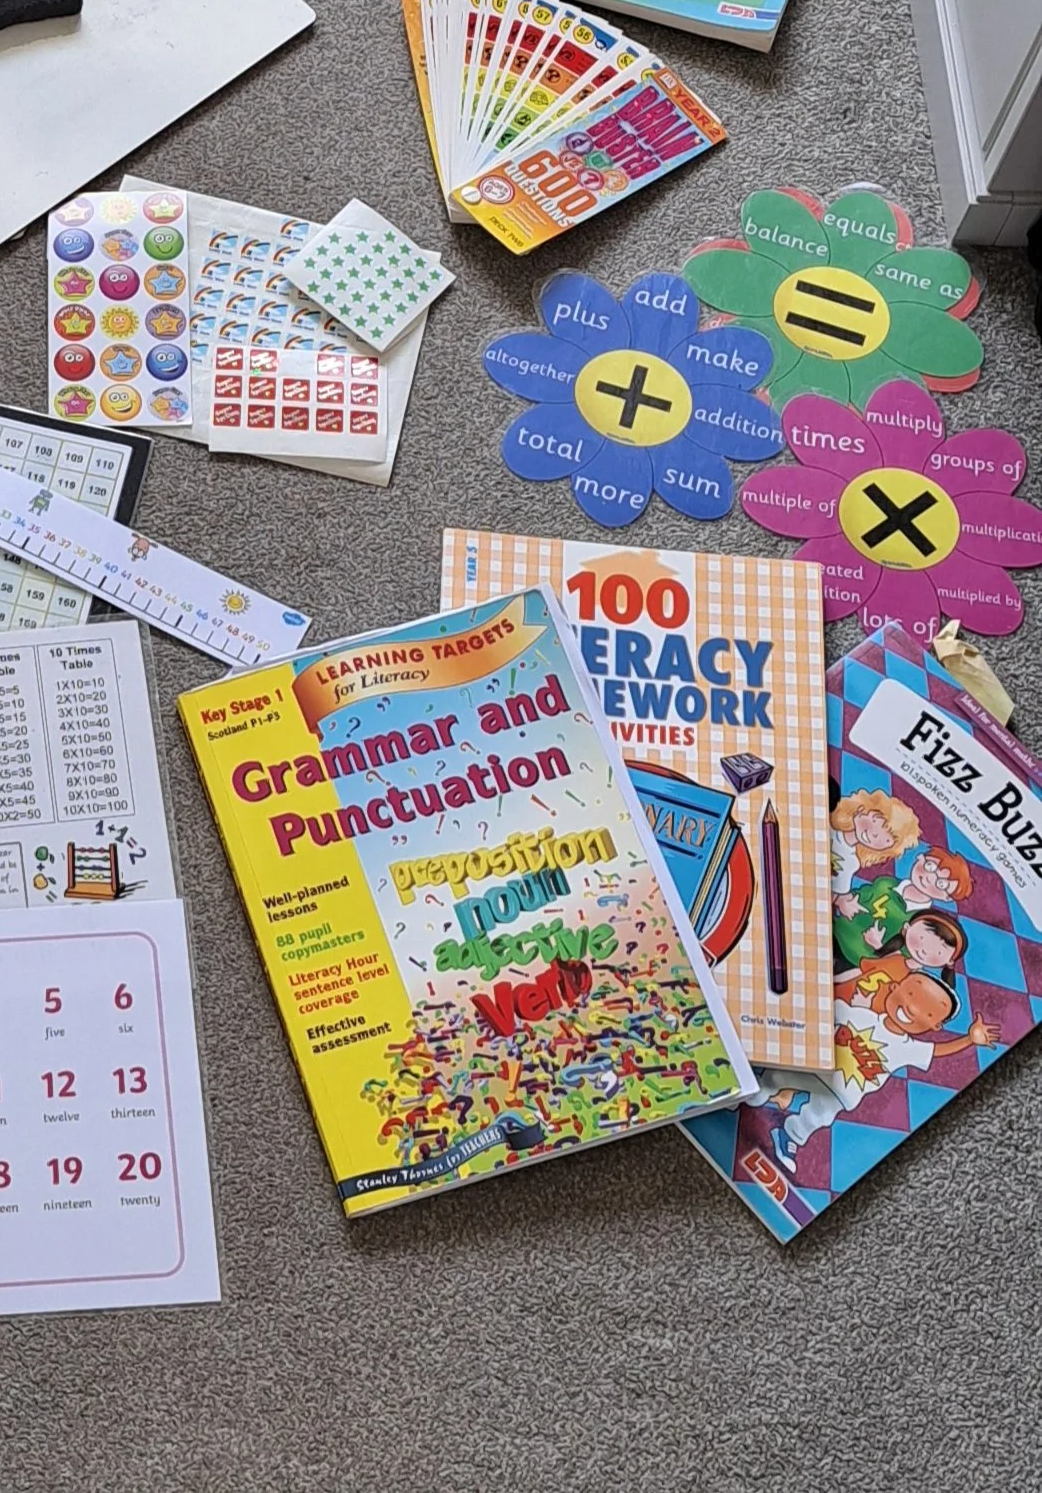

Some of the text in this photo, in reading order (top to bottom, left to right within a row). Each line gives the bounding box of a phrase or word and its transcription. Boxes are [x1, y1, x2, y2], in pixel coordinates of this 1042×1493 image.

[673, 88, 721, 138] YEAR 2
[505, 162, 575, 228] QUESTIONS
[518, 150, 598, 218] 600
[744, 215, 828, 258] balance
[823, 209, 897, 245] equals
[874, 260, 963, 301] same as
[553, 302, 609, 333] plus
[634, 287, 687, 318] add
[484, 347, 576, 384] altogether
[685, 342, 760, 377] make
[692, 406, 785, 445] addition
[791, 425, 867, 454] times
[866, 411, 944, 438] multiply
[517, 426, 584, 464] total
[661, 465, 723, 500] sum
[930, 453, 1024, 481] groups of
[573, 474, 646, 510] more
[741, 487, 837, 519] multiple of
[466, 545, 477, 584] YEAR 5
[566, 570, 691, 630] 100
[937, 587, 1022, 611] multiplied by
[315, 617, 516, 686] LEARNING TARGETS
[333, 666, 430, 705] for Literacy
[200, 689, 285, 726] Key Stage 1
[230, 673, 572, 804] Grammar and
[899, 710, 983, 794] Fizz
[269, 746, 572, 858] Punctuation
[387, 826, 619, 906] preposition
[262, 875, 350, 910] Well-planned
[453, 866, 572, 942] noun
[266, 899, 319, 925] lessons
[276, 922, 333, 949] 88 pupil
[280, 928, 366, 963] copymasters
[432, 916, 620, 982] adjective
[288, 952, 380, 987] Literacy Hour
[306, 1014, 367, 1041] Effective
[311, 1020, 392, 1055] assessment
[110, 1106, 157, 1120] thirteen
[45, 1155, 84, 1186] 19
[116, 1151, 162, 1182] 20
